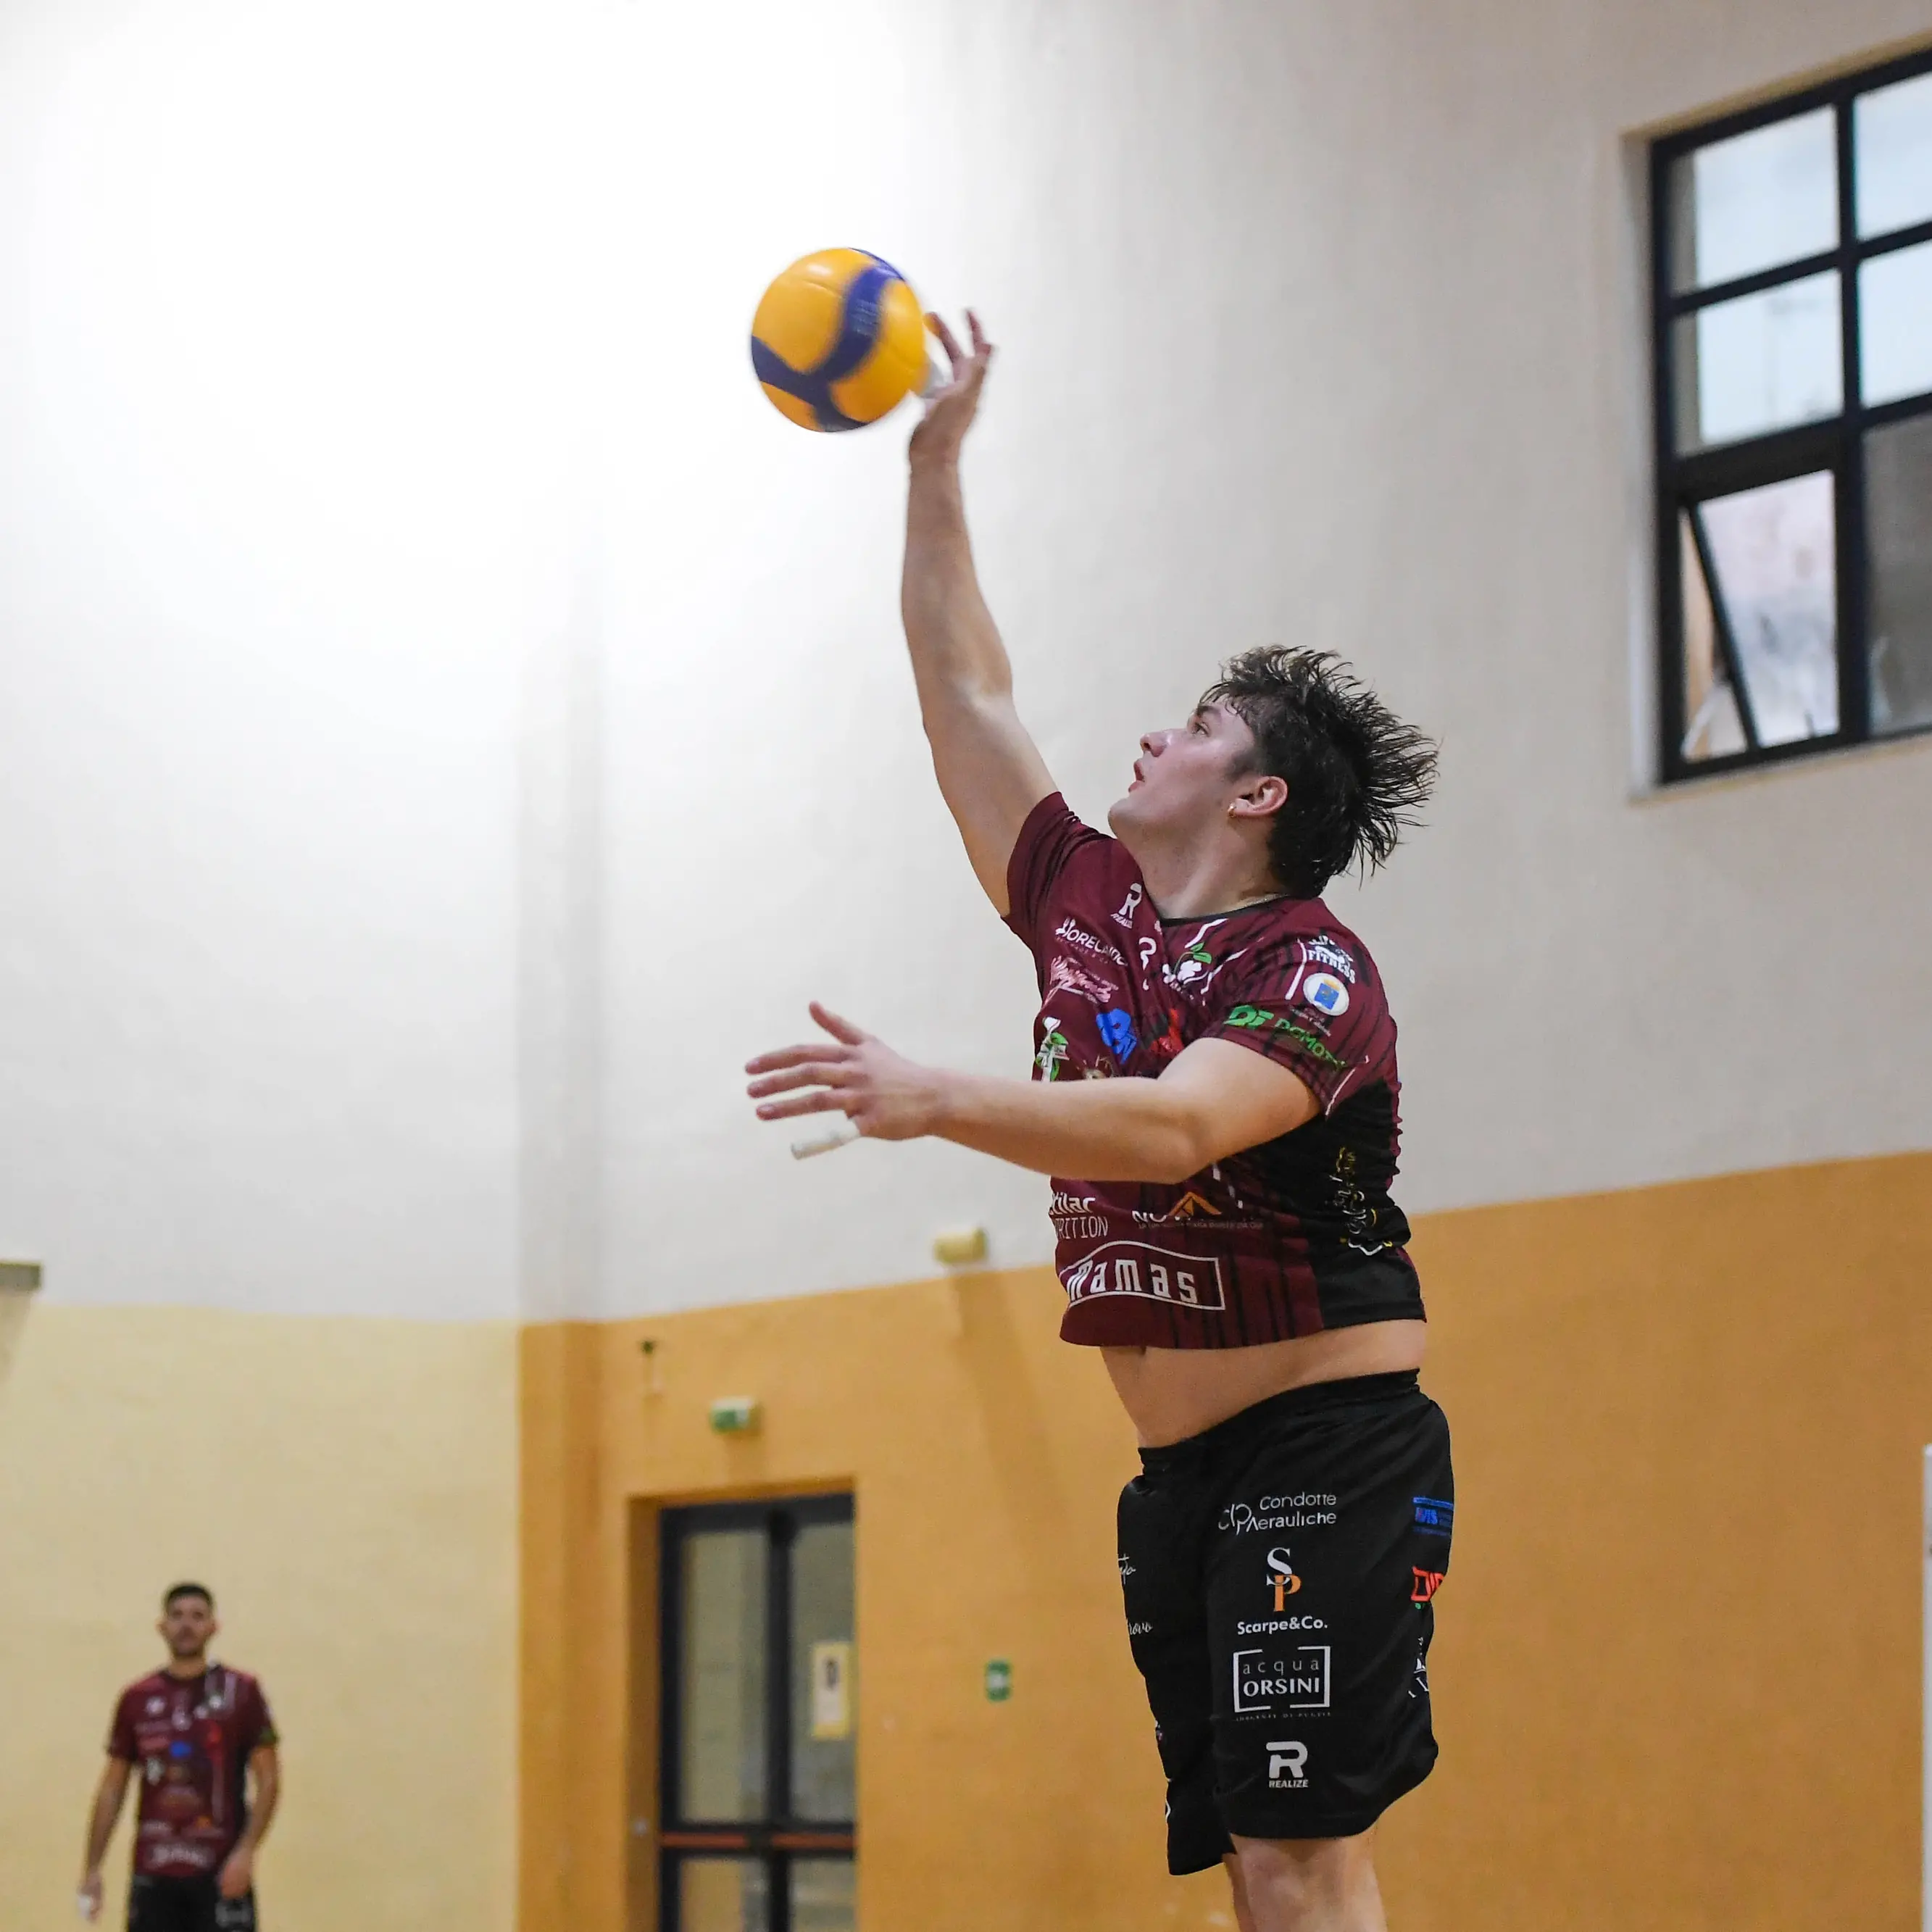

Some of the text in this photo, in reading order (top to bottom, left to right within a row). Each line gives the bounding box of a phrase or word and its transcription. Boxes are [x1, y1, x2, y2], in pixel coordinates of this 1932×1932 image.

[1307, 950, 1356, 984] FITNESS
[1259, 1491, 1337, 1510] Condotte
[1237, 1615, 1328, 1635] Scarpe&Co.
[1242, 1659, 1320, 1675] acqua
[1242, 1677, 1320, 1697] ORSINI
[1268, 1779, 1309, 1789] REALIZE
